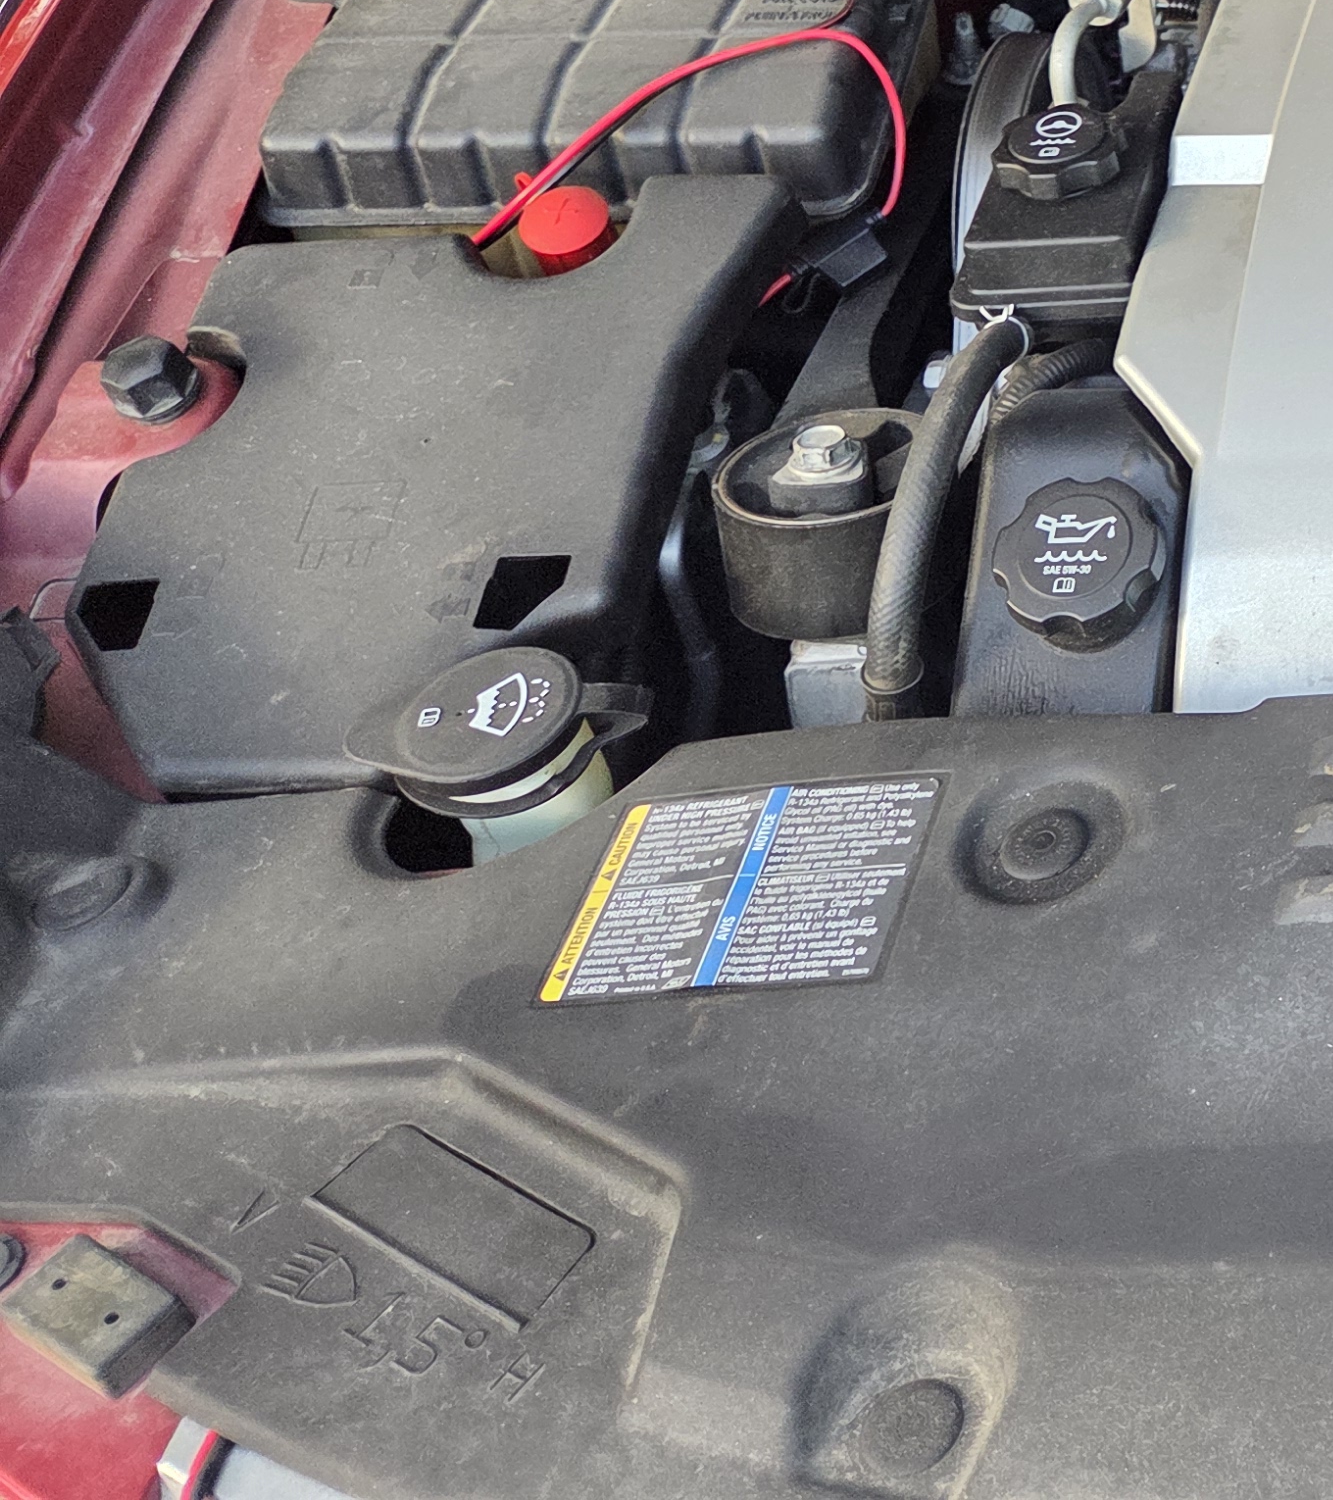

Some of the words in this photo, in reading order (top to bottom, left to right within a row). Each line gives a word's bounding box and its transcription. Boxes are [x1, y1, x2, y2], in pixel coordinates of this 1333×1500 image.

[1043, 566, 1062, 575] SAE
[1062, 565, 1092, 575] 5W-30
[609, 822, 638, 866] CAUTION
[752, 813, 778, 851] NOTICE
[562, 907, 599, 964] ATTENTION
[715, 916, 736, 941] AVIS
[490, 1351, 546, 1404] H
